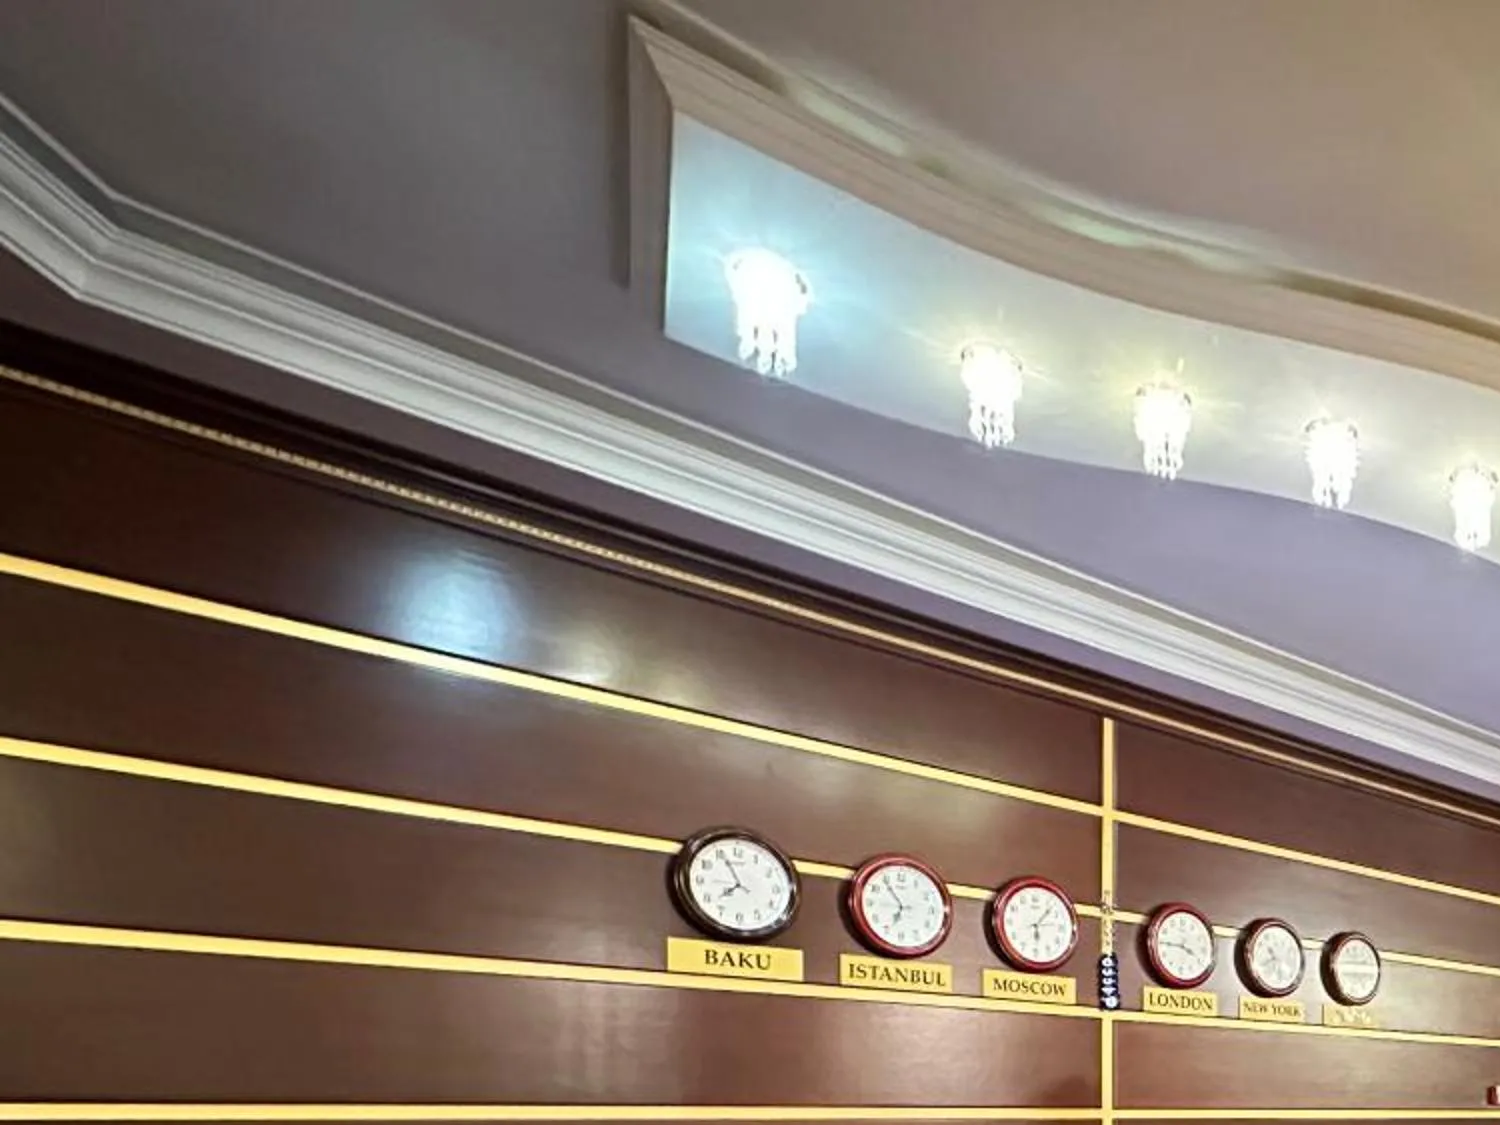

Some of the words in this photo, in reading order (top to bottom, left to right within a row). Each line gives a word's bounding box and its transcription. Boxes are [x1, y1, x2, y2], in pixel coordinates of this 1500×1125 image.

[704, 949, 772, 971] BAKU
[844, 963, 947, 987] ISTANBUL
[992, 978, 1067, 997] MOSCOW
[1149, 992, 1213, 1011] LONDON
[1243, 1002, 1267, 1014] NEW
[1270, 1003, 1300, 1017] YORK
